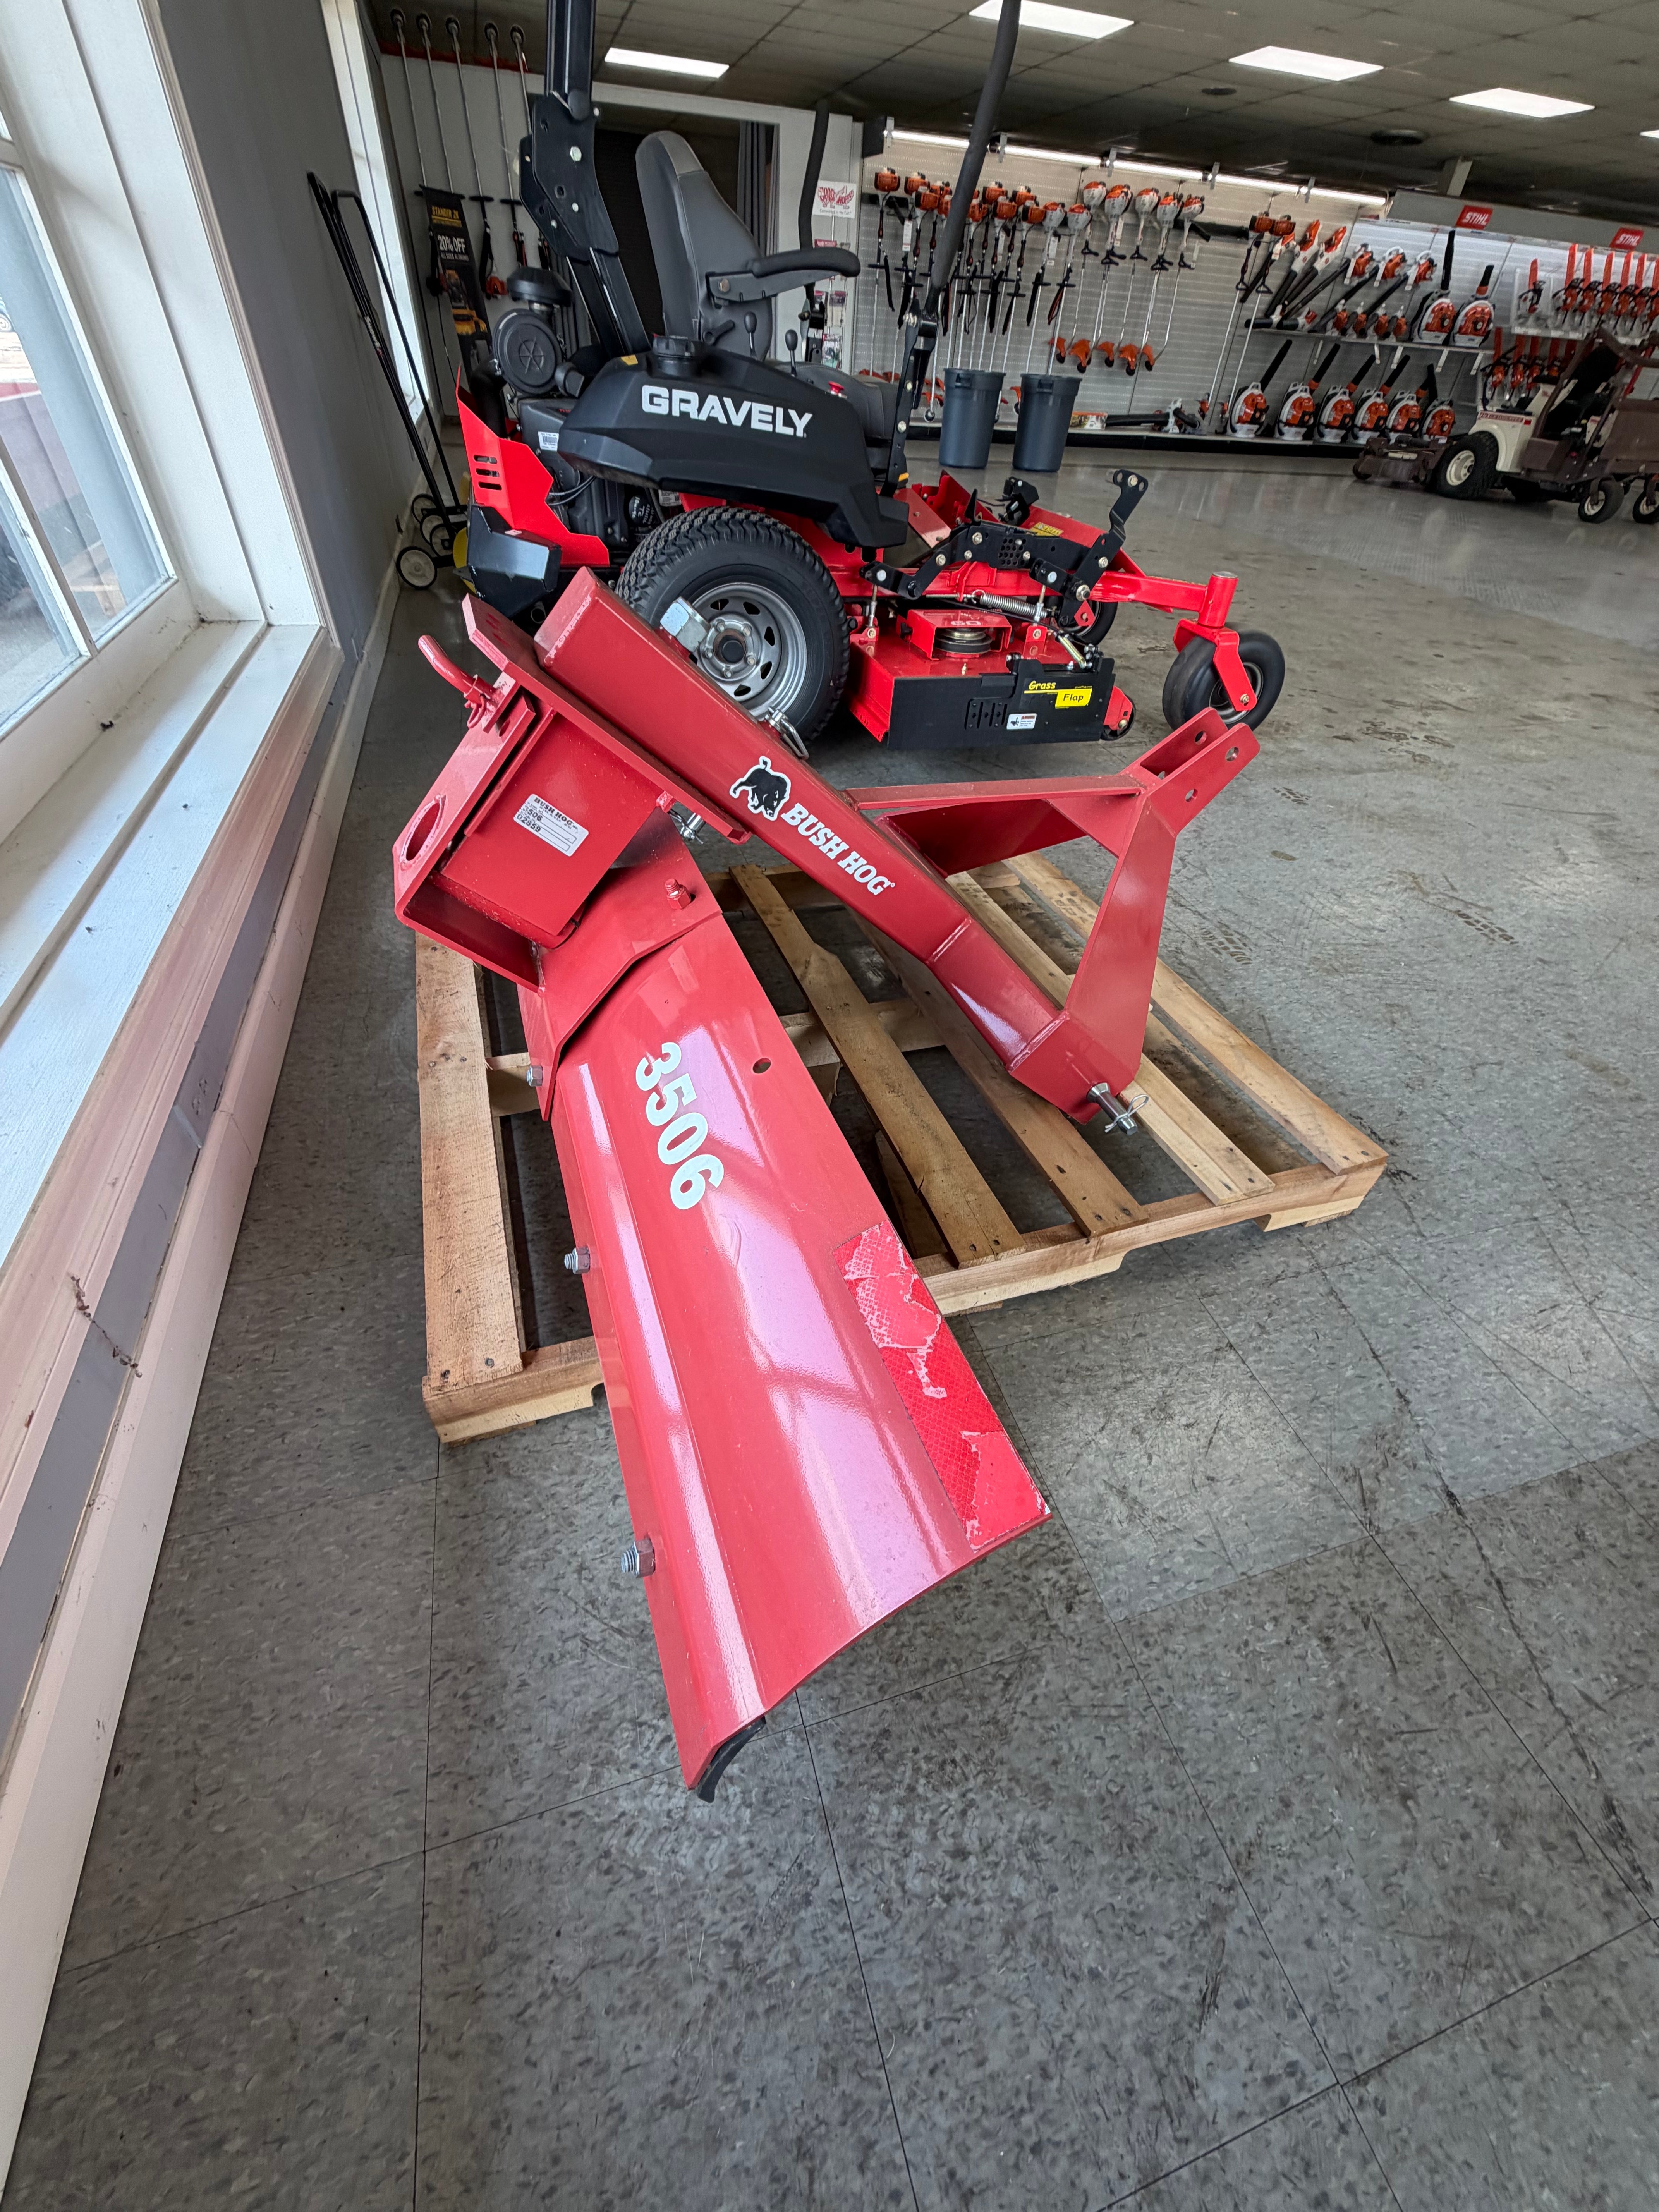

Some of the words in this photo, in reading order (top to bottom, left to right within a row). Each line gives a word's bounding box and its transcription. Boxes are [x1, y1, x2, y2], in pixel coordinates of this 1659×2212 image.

[1462, 212, 1489, 225] STIHL
[437, 234, 454, 252] 20%
[452, 236, 465, 253] OFF
[1615, 234, 1640, 246] STIHL
[642, 385, 812, 438] GRAVELY
[1029, 680, 1056, 690] Grass
[1063, 694, 1084, 702] Flap
[523, 805, 543, 821] 3506
[534, 797, 555, 814] BUSH
[555, 812, 573, 825] HOG
[517, 814, 541, 833] 02859
[780, 803, 849, 860] BUSH
[837, 851, 891, 896] HOG
[635, 1042, 724, 1210] 3506
